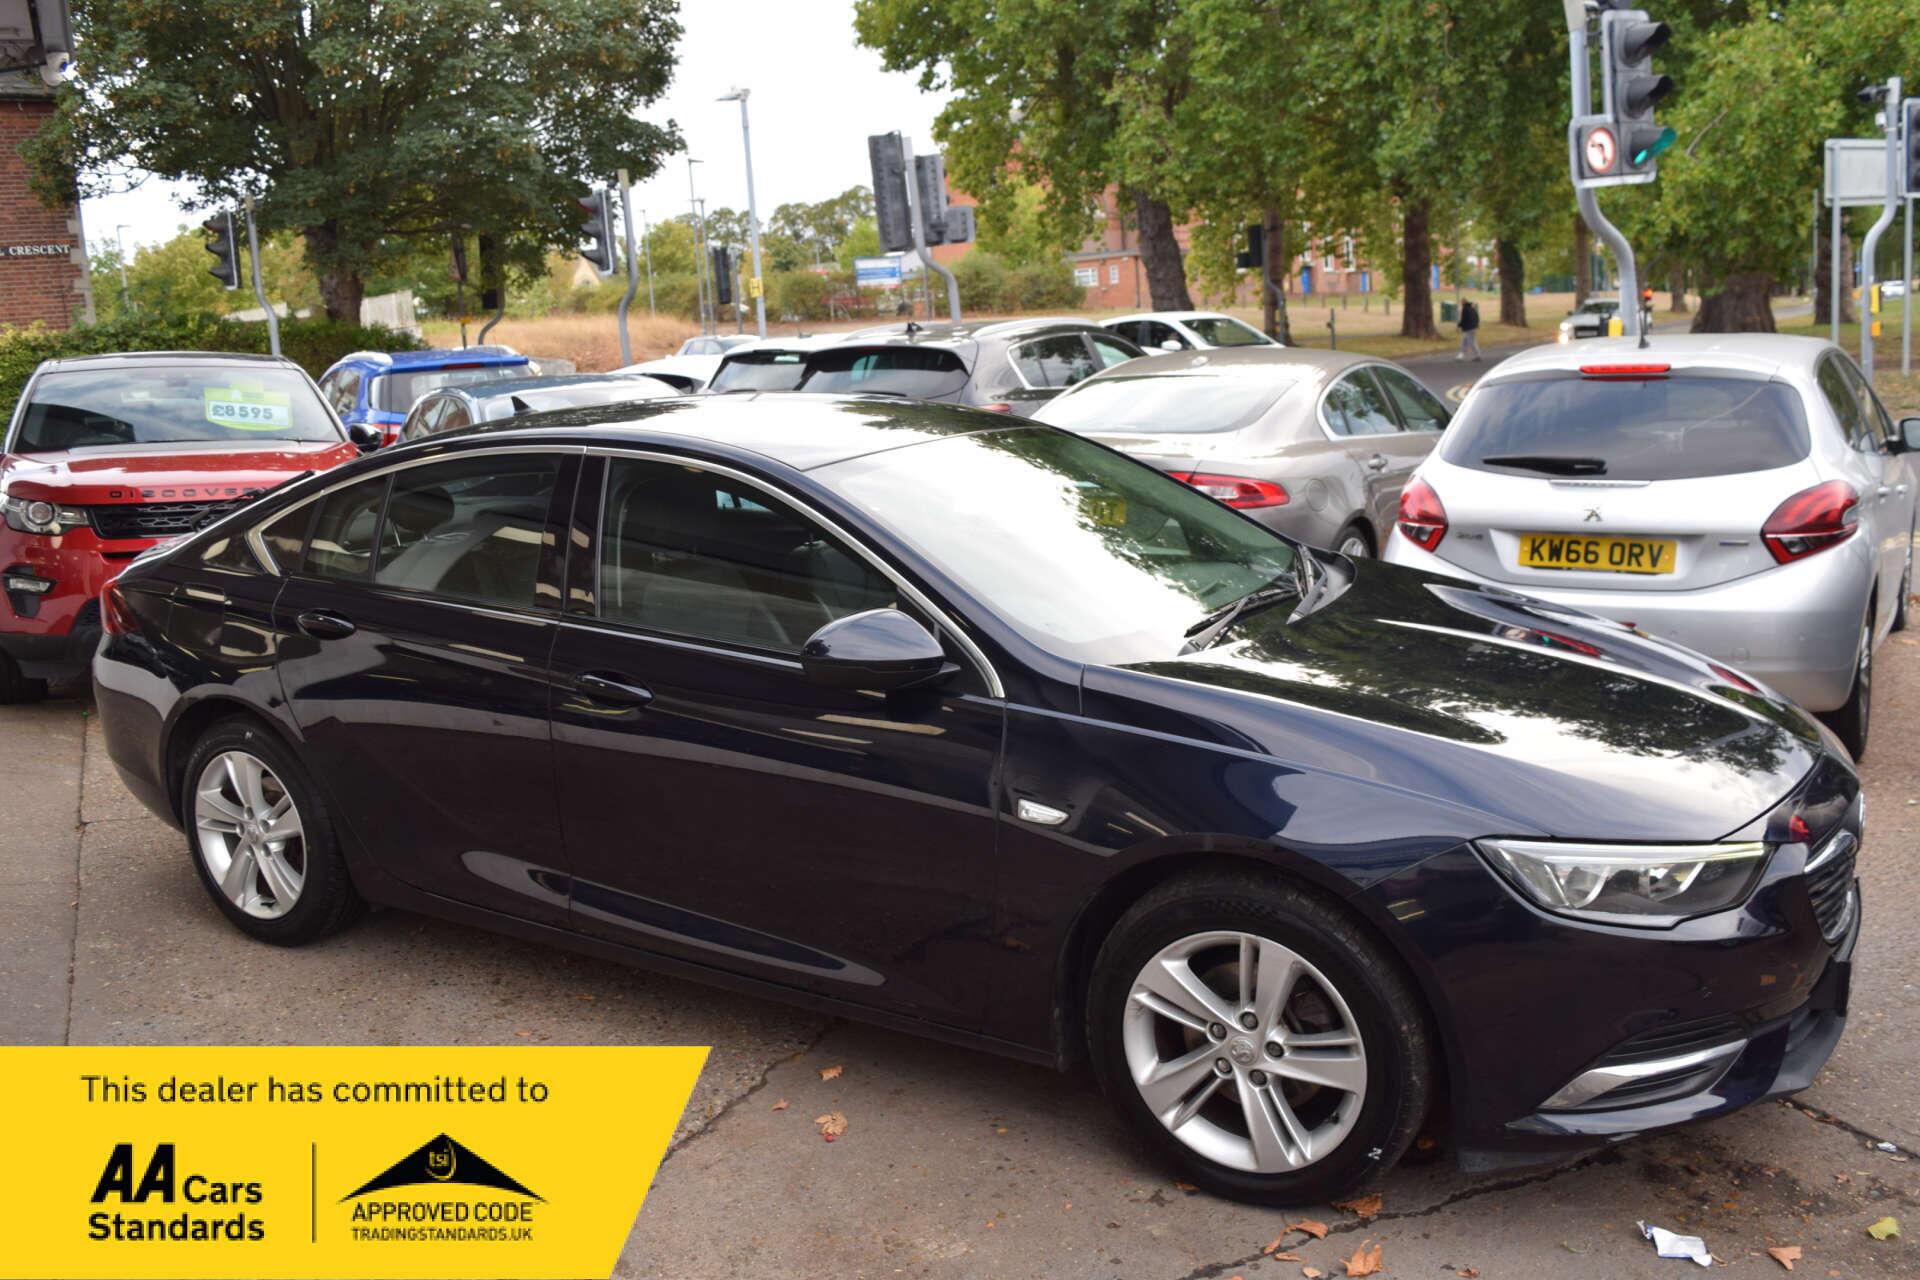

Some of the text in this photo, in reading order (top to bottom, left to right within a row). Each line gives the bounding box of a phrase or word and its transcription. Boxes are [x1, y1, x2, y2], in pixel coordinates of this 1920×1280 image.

[9, 244, 71, 256] CRESCENT
[212, 404, 273, 420] £8595
[1529, 538, 1664, 568] KW66 ORV
